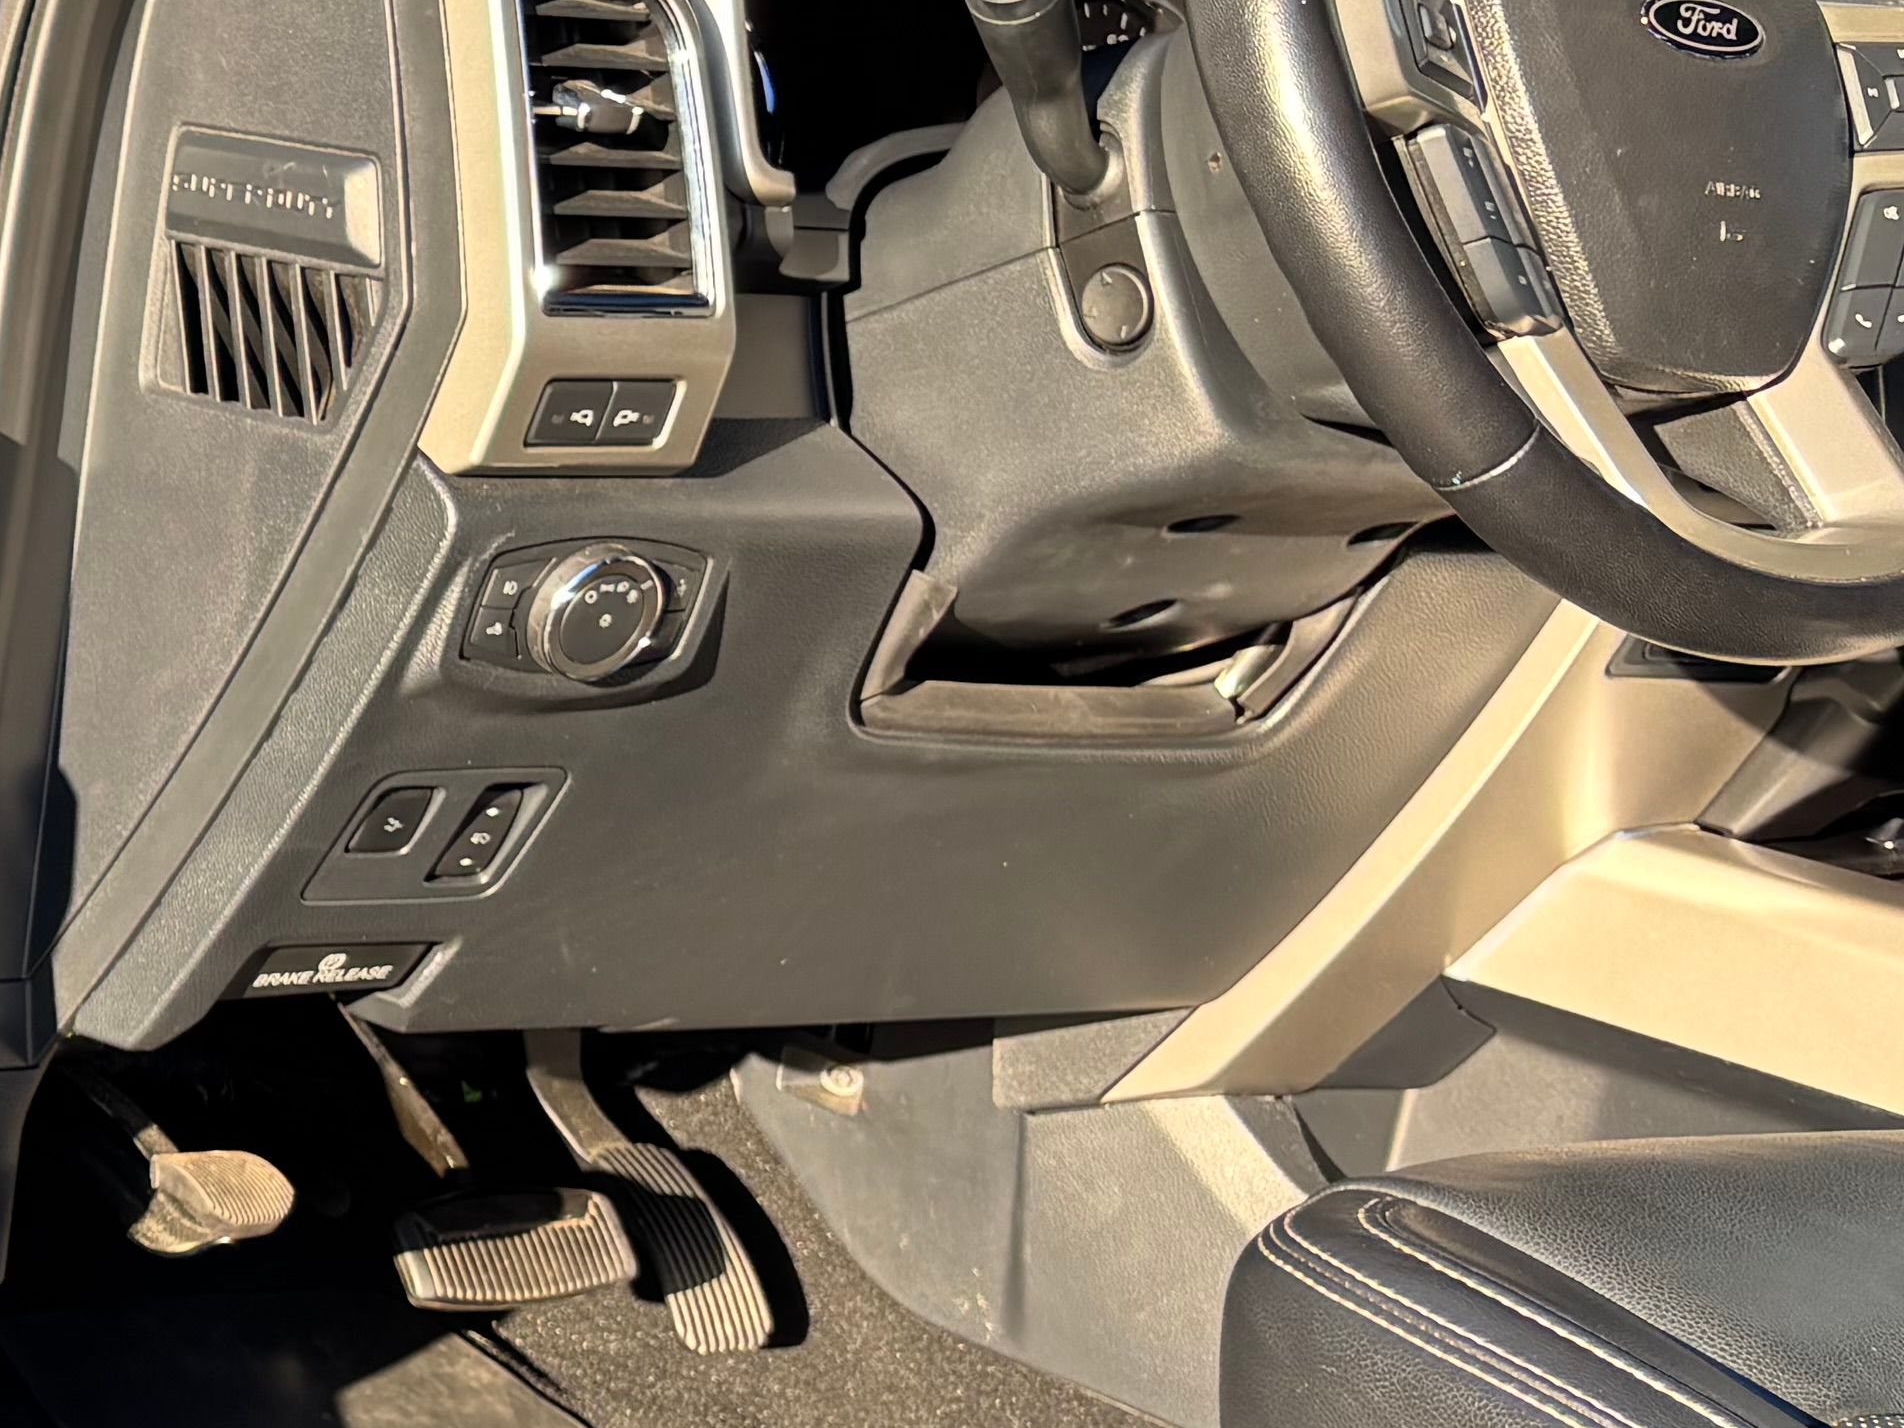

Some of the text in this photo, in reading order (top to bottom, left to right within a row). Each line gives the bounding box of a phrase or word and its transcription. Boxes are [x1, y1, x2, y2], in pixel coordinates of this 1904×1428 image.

[1677, 3, 1739, 41] Ford
[252, 964, 394, 988] BRAKE RELEASE
